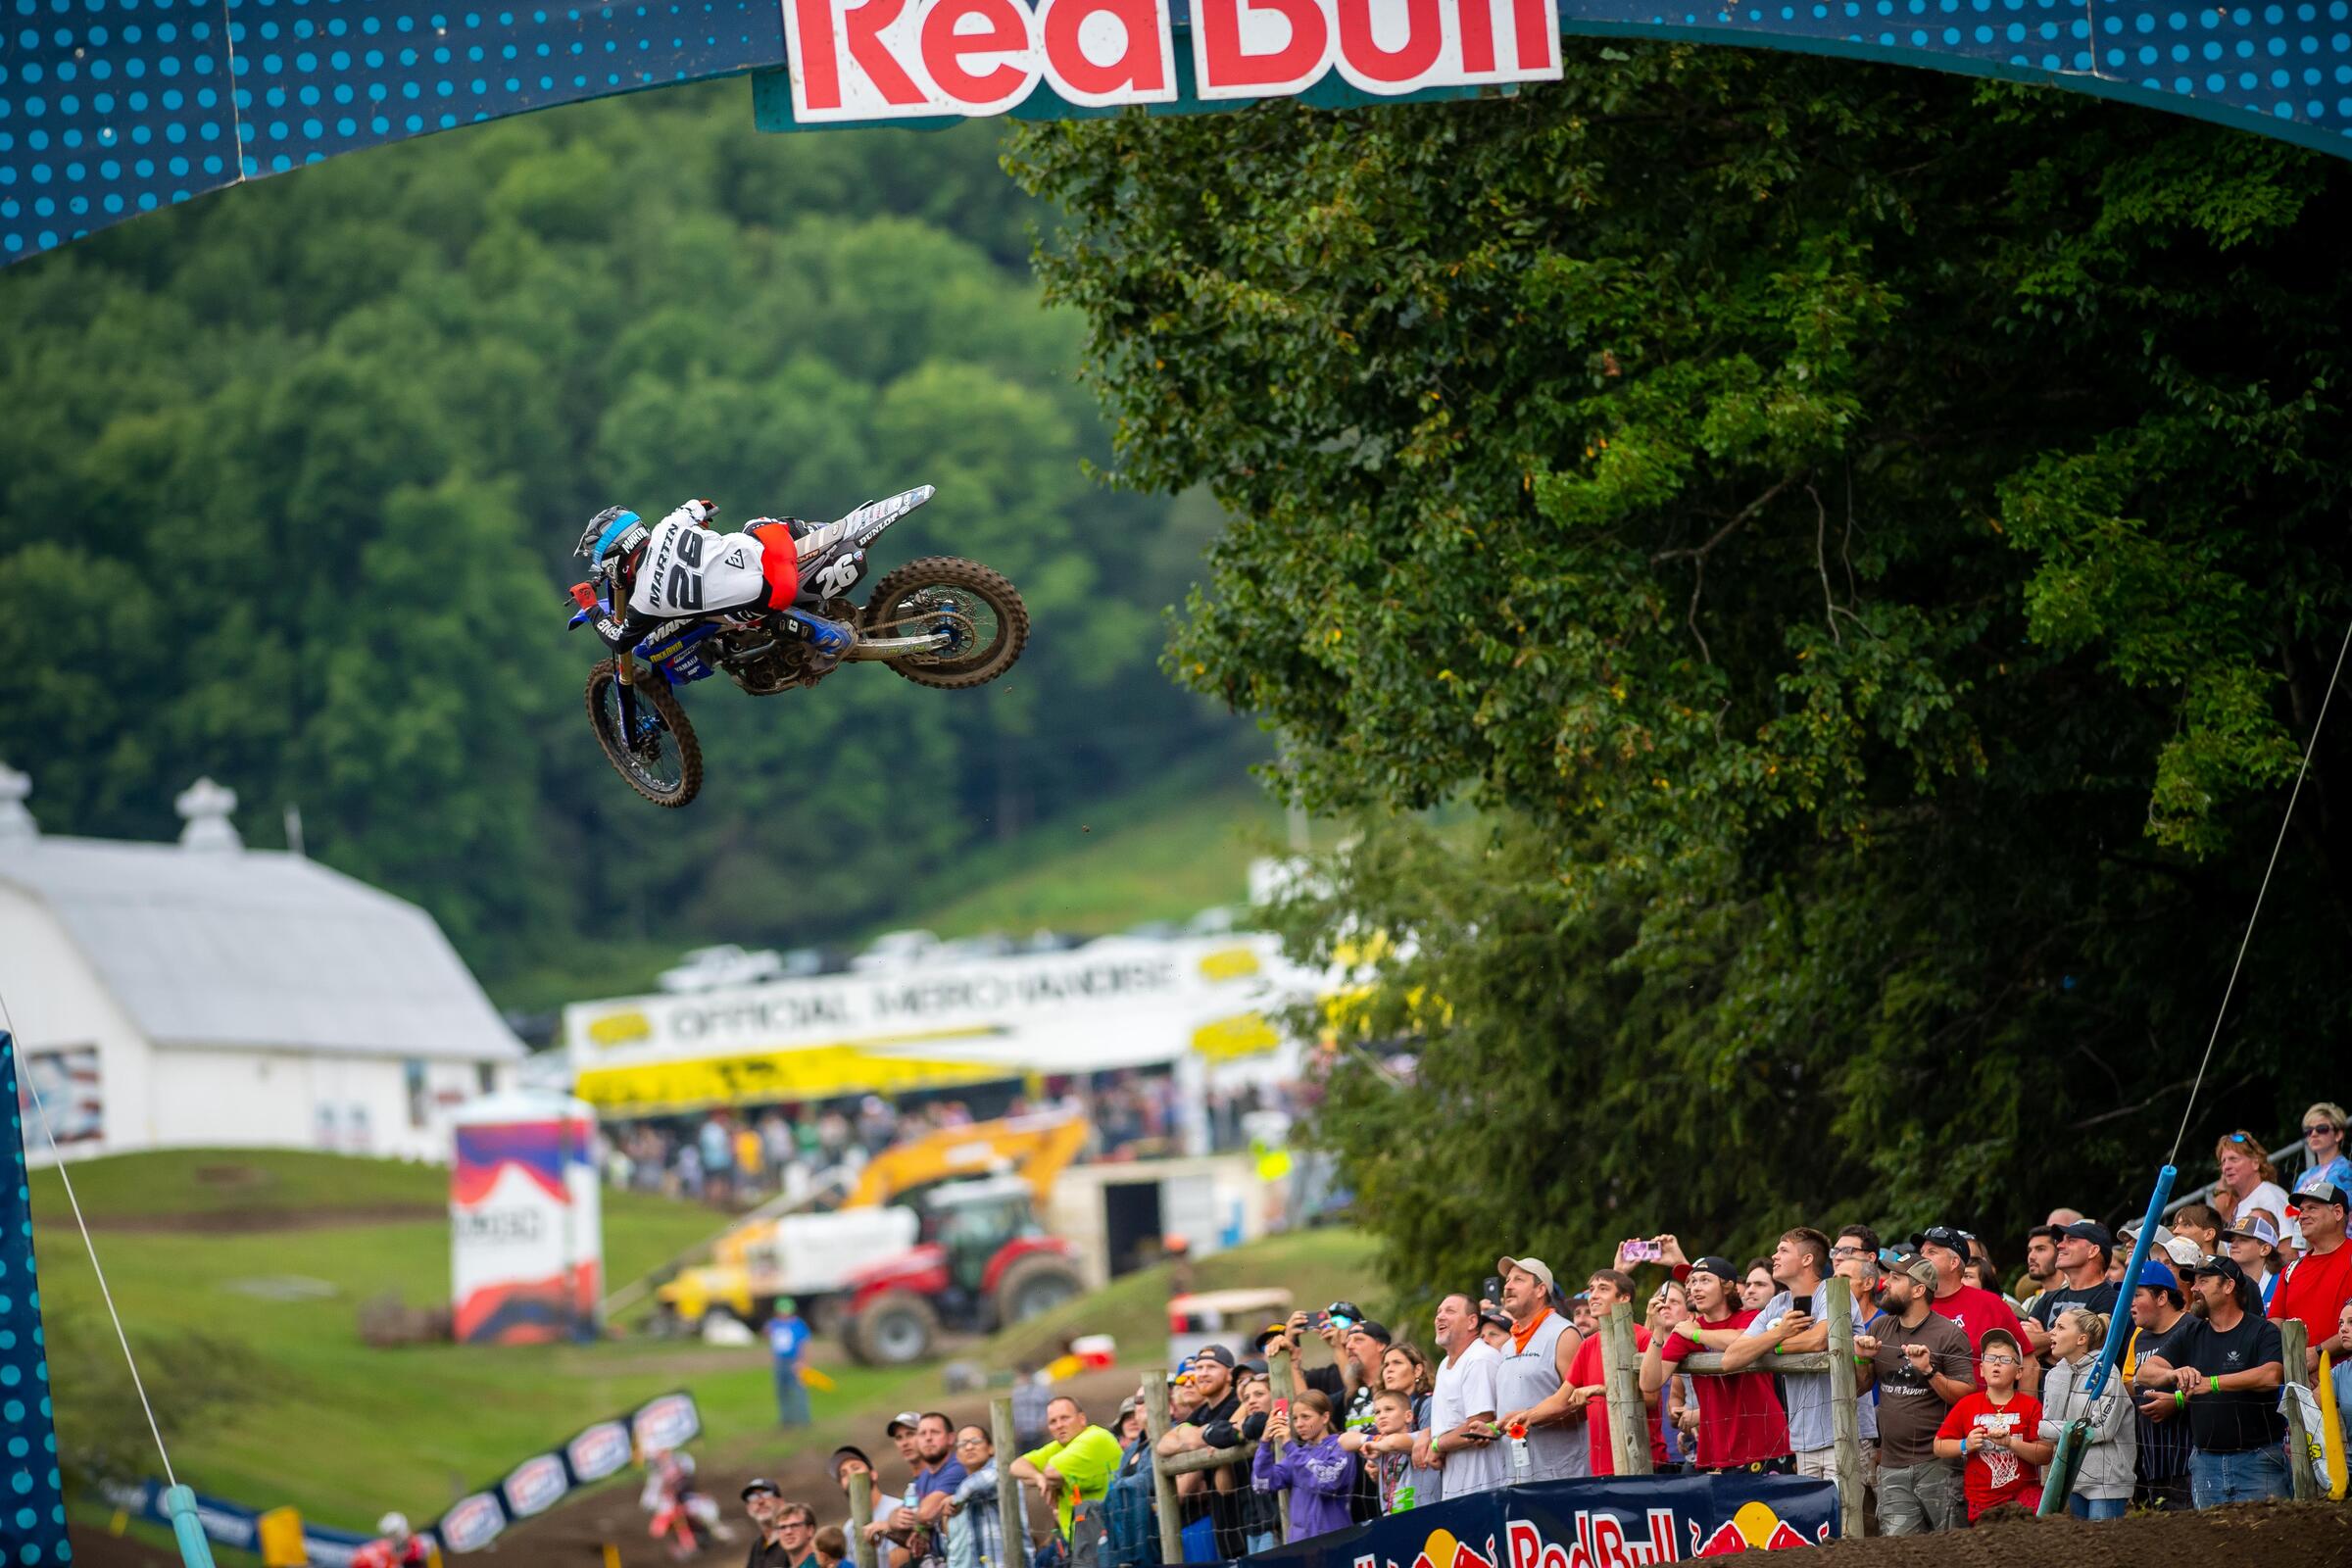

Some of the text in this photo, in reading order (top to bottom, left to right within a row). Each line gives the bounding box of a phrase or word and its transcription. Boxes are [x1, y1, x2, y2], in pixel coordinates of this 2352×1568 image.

[858, 513, 899, 546] DUNLOP
[649, 523, 680, 610] MARTIN
[815, 553, 858, 600] 26
[668, 996, 847, 1041] OFFICIAL
[873, 959, 1179, 1016] MERCHANDISE
[1506, 1508, 1679, 1568] Red Bull
